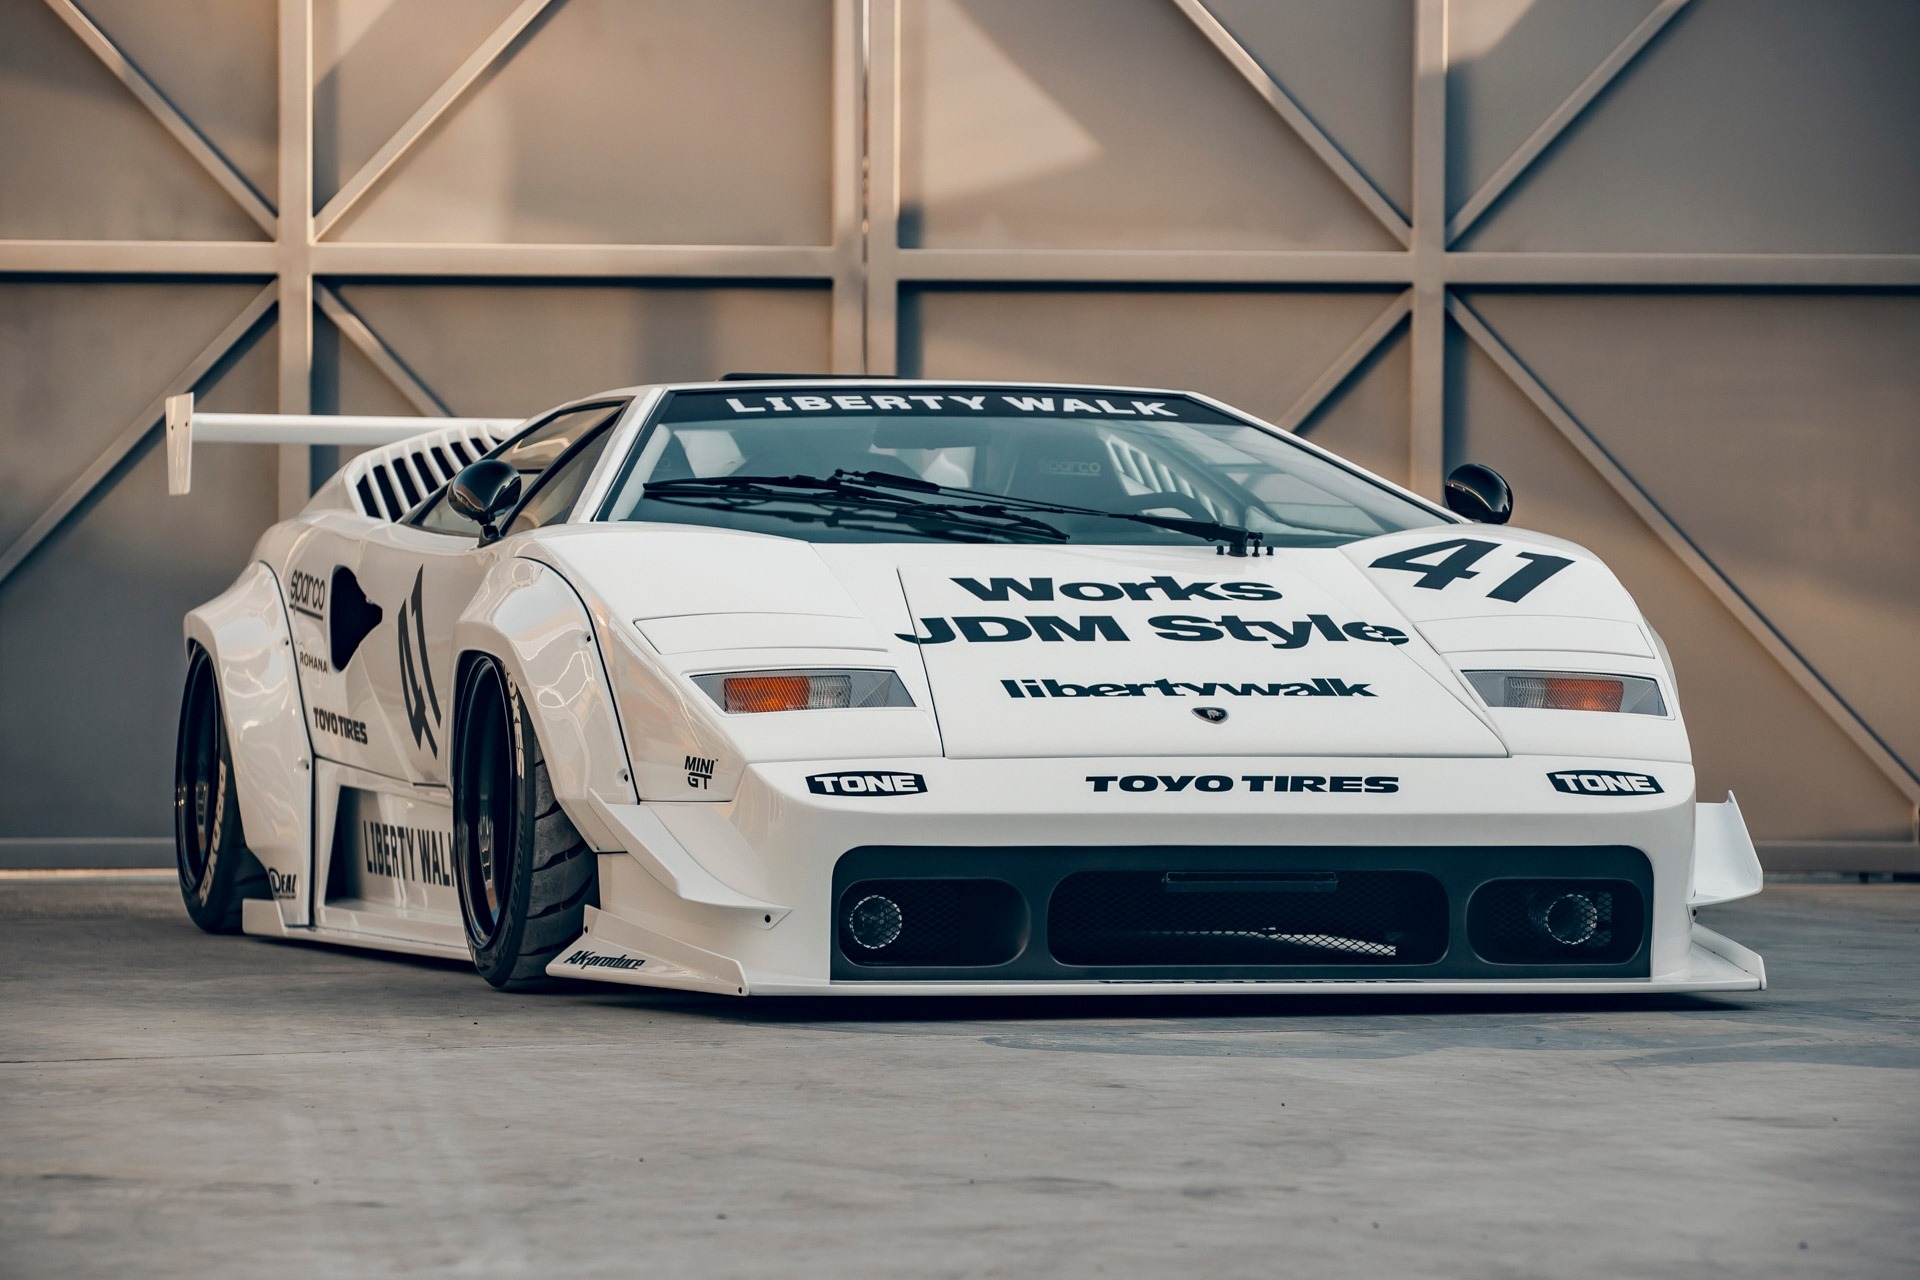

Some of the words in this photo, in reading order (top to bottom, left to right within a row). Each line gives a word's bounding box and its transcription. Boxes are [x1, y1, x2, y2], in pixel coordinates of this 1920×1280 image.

[725, 394, 986, 413] LIBERTY
[1001, 396, 1179, 418] WALK
[1367, 538, 1577, 604] 41
[288, 569, 326, 615] sparco
[949, 575, 1283, 602] Works
[893, 615, 1131, 646] JDM
[1147, 613, 1410, 650] Style
[299, 651, 328, 674] ROHANA
[397, 563, 442, 761] 41
[999, 678, 1379, 699] libertywalk
[312, 706, 338, 736] TOYO
[337, 714, 368, 745] TIRES
[684, 755, 715, 775] MINI
[687, 771, 712, 790] GT
[814, 774, 919, 793] TONE
[1085, 774, 1234, 793] TOYO
[1241, 775, 1400, 794] TIRES
[1554, 773, 1657, 792] TONE
[363, 820, 415, 882] LIBERTY
